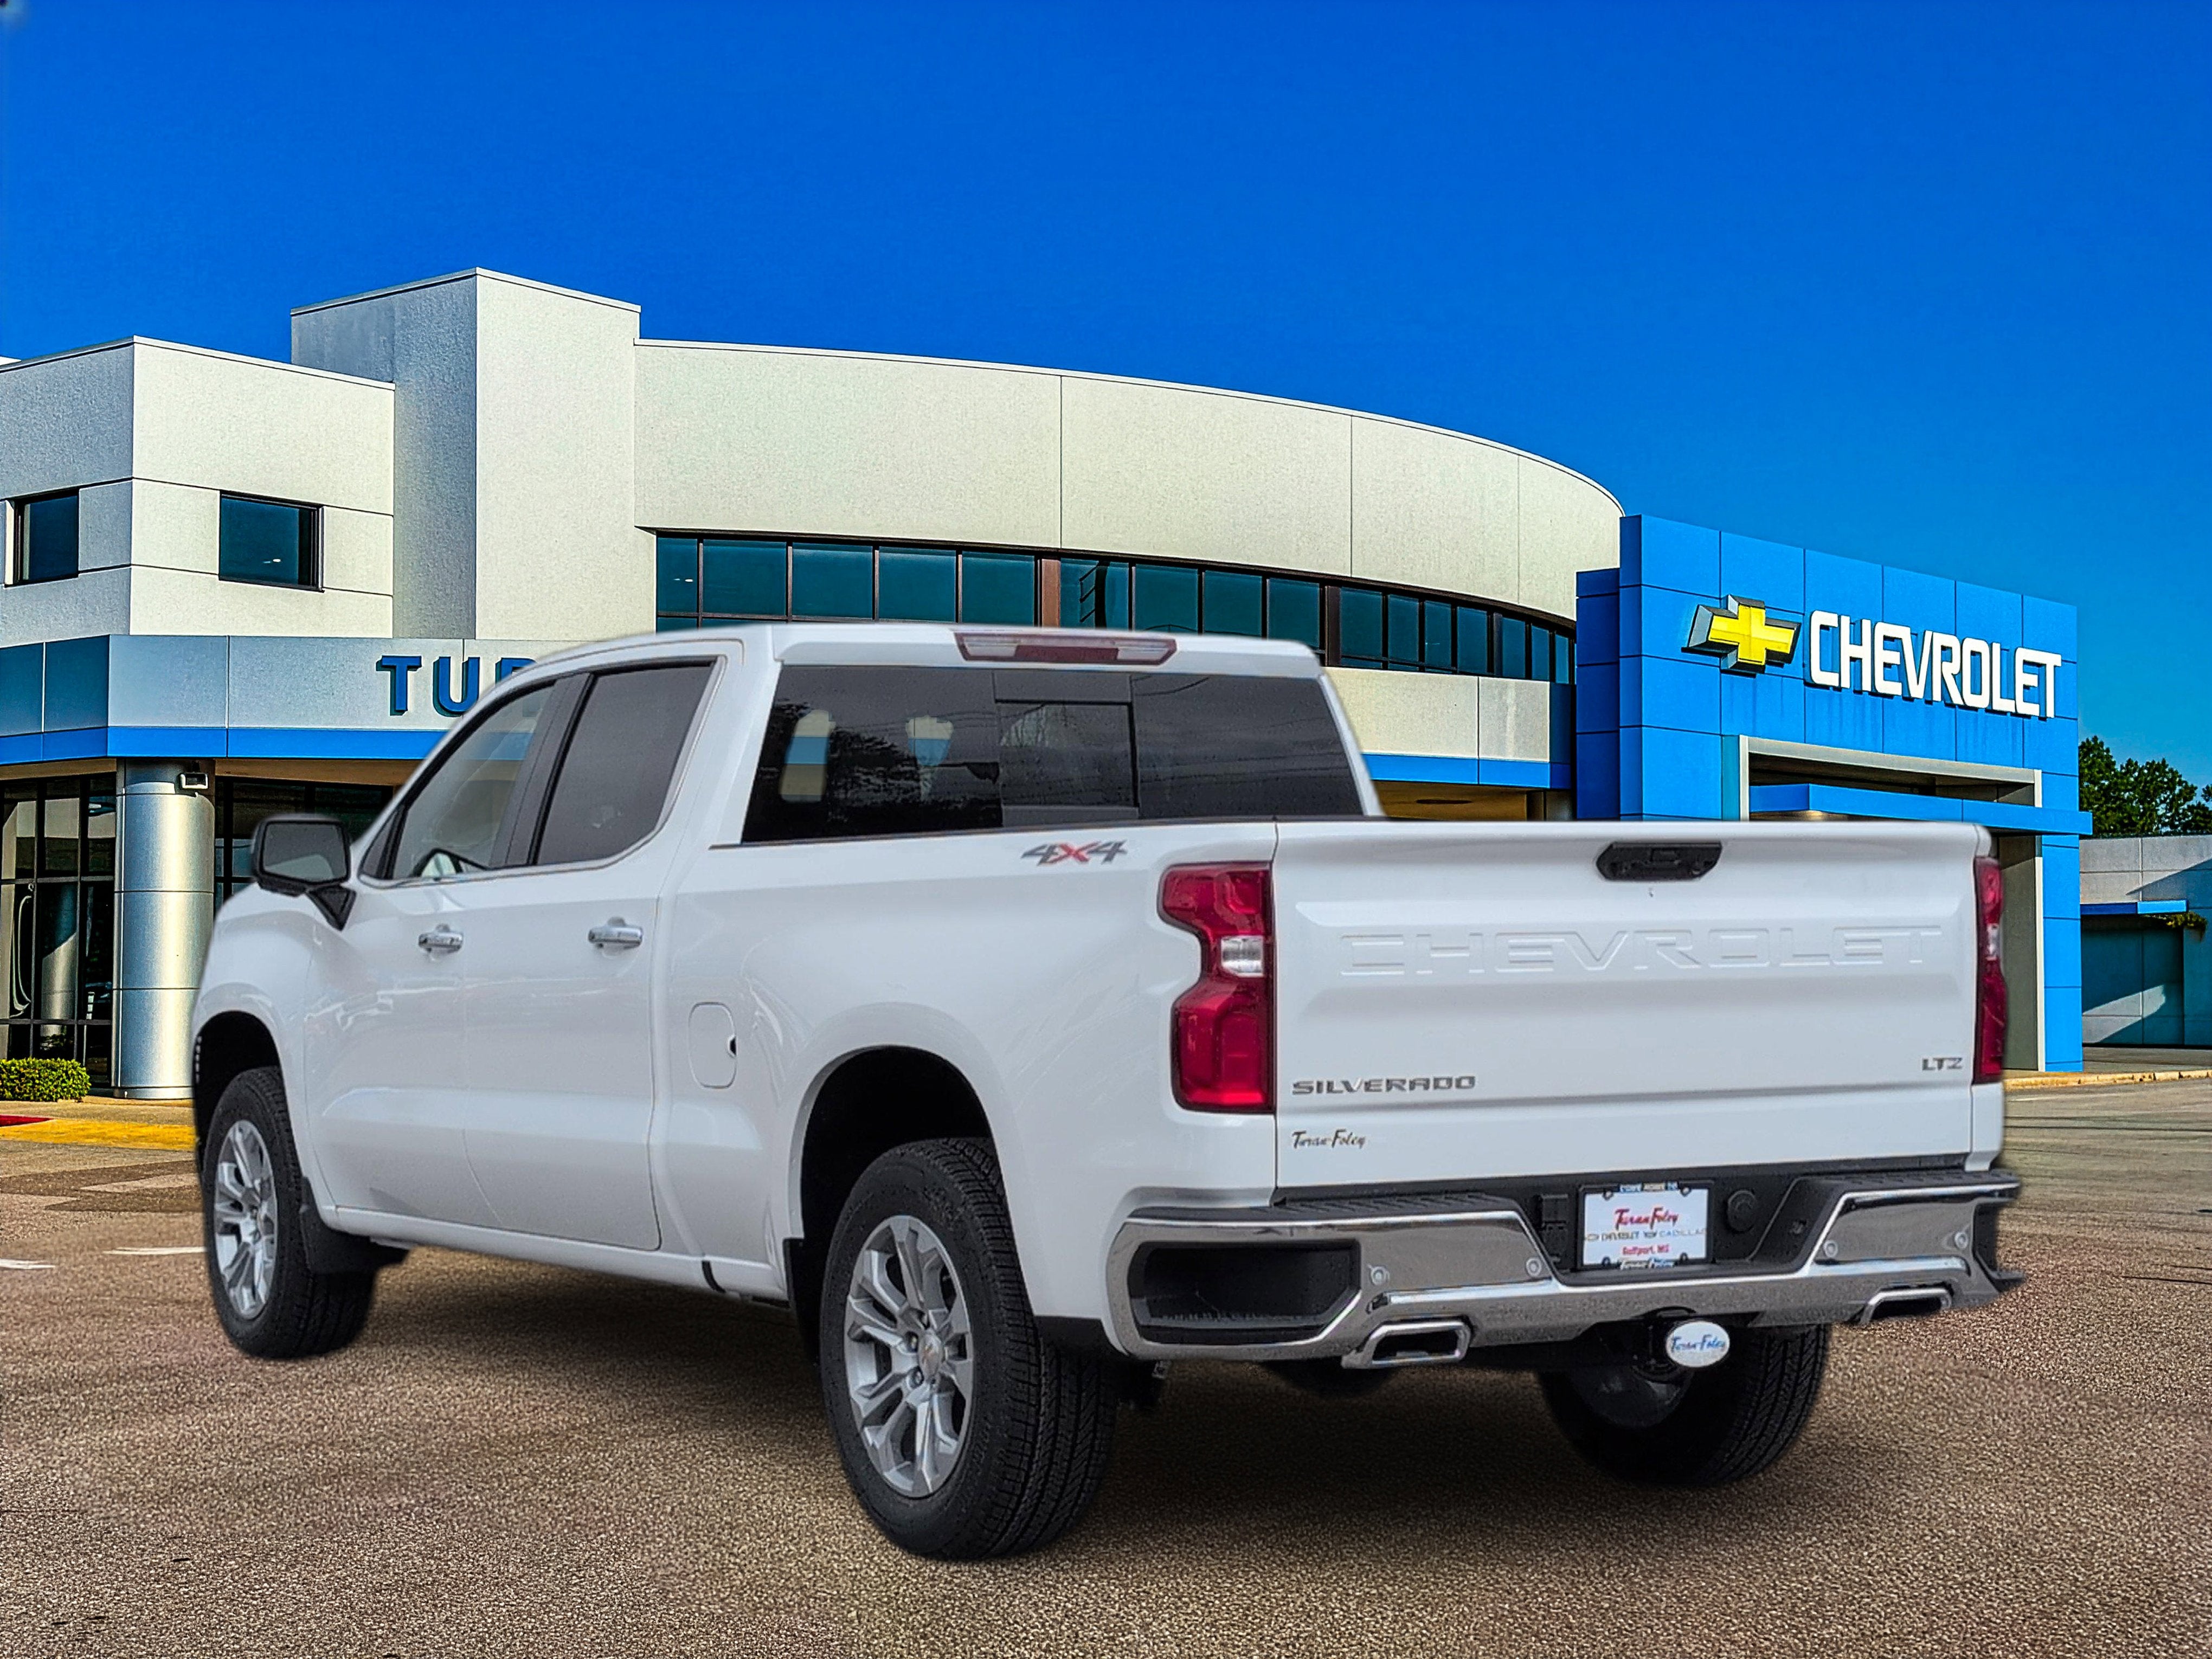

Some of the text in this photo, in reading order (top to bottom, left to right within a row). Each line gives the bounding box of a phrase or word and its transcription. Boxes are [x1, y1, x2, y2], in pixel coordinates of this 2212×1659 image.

[1810, 610, 2061, 718] CHEVROLET
[1340, 926, 1942, 975] CHEVROLET
[1922, 1057, 1963, 1071] LTZ
[1292, 1076, 1476, 1096] SILVERADO
